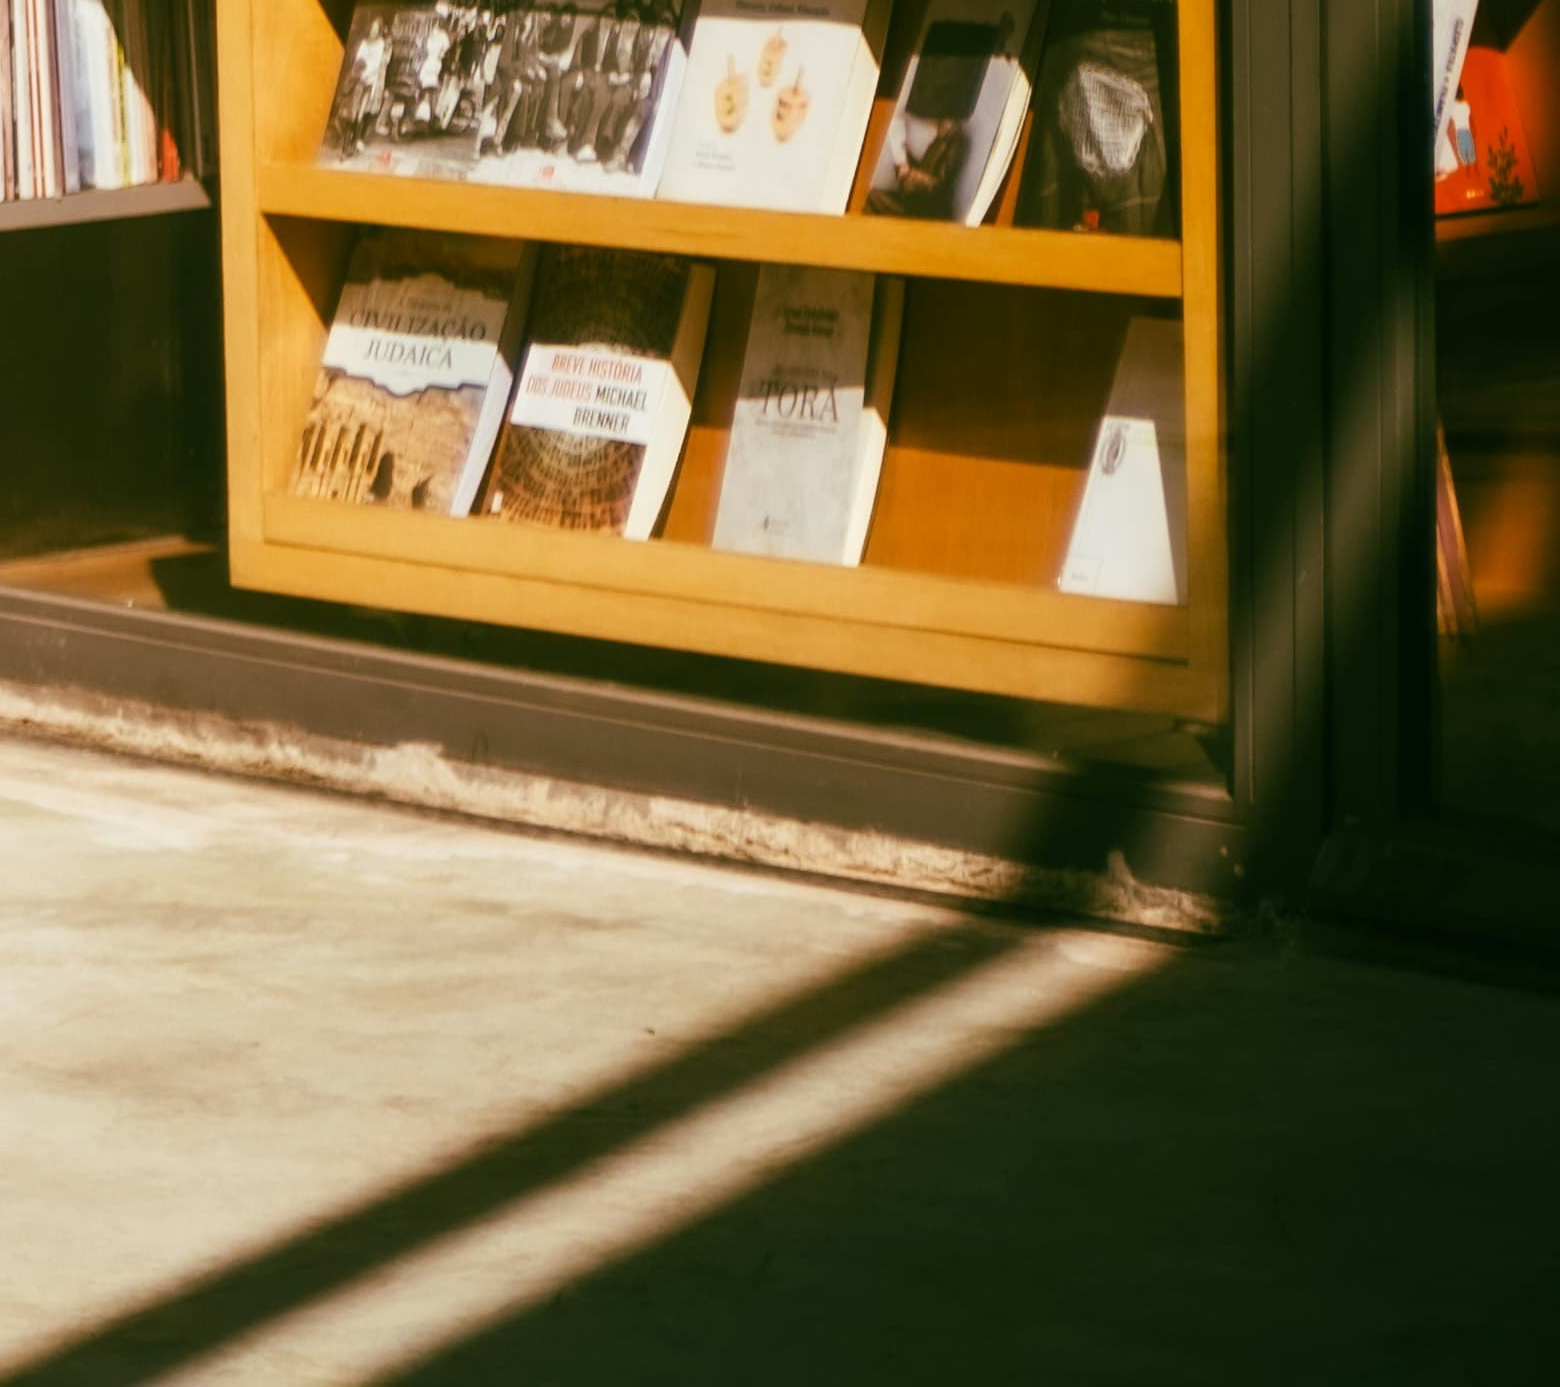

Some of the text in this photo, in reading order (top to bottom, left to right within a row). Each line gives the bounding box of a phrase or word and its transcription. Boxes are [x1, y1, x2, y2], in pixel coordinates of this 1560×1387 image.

[349, 309, 488, 343] CIVILIZAÇÃO
[363, 337, 453, 370] JUDAICA
[594, 383, 648, 412] MICHAEL
[759, 374, 839, 423] TORÁ
[572, 406, 631, 435] BRENNER
